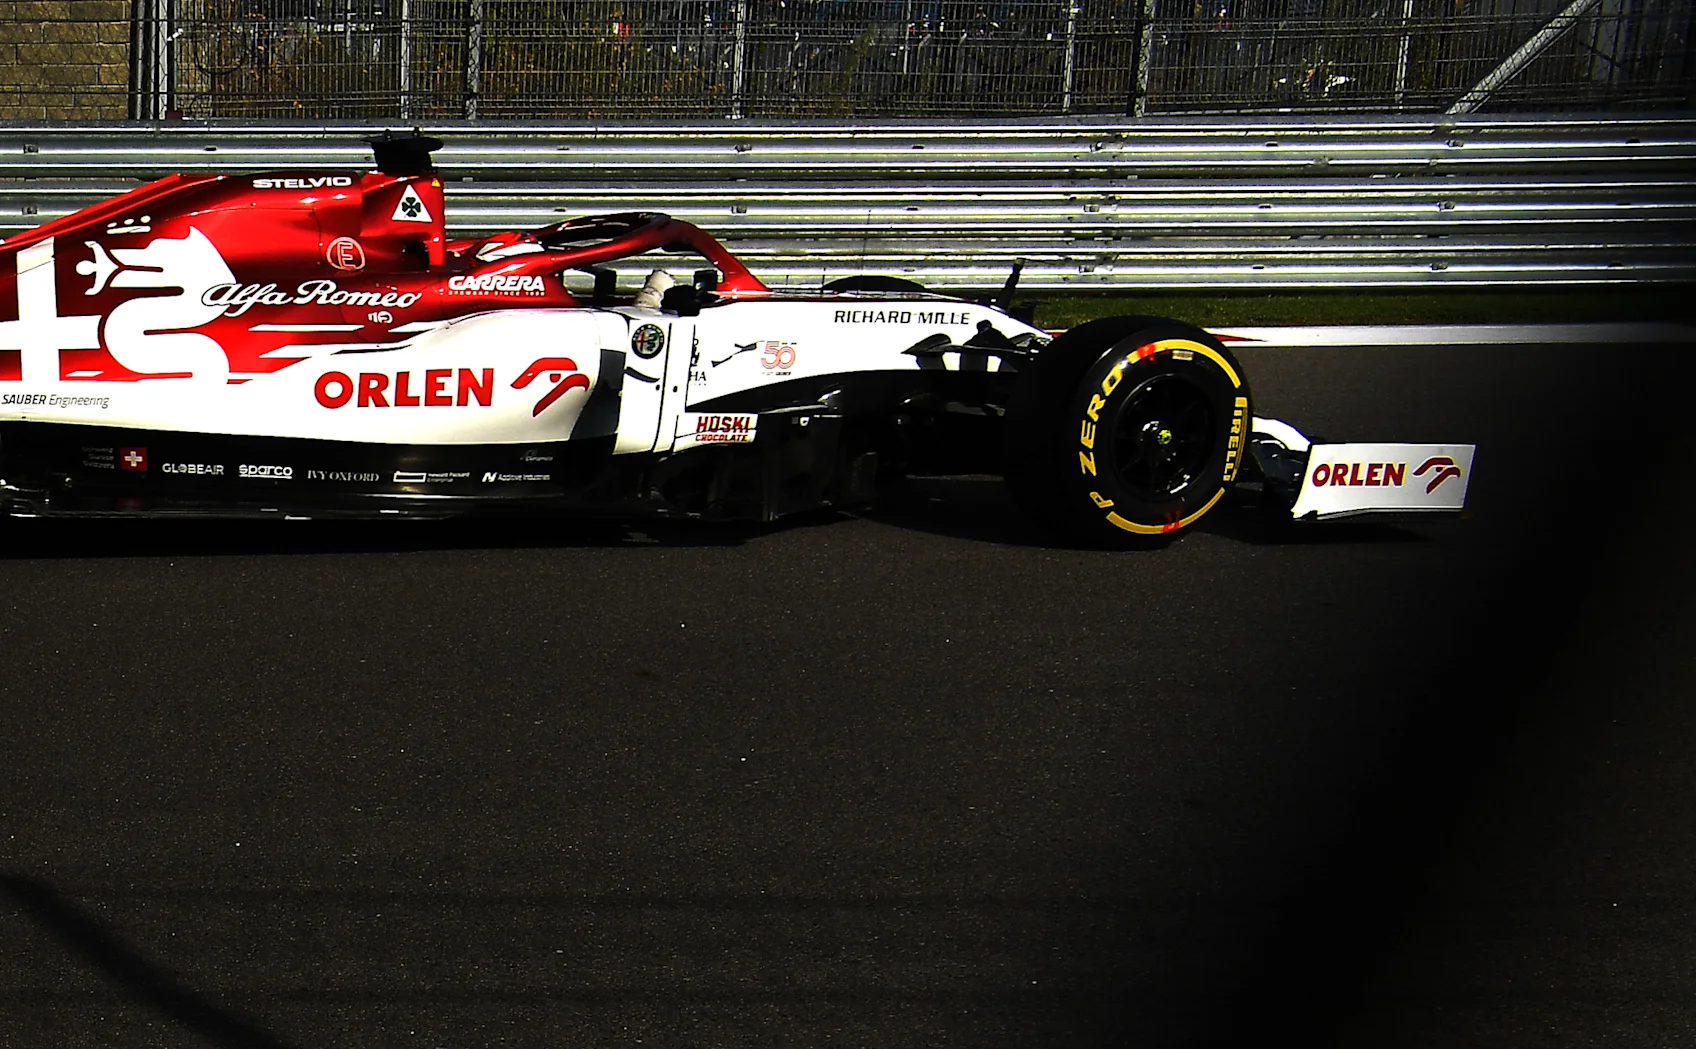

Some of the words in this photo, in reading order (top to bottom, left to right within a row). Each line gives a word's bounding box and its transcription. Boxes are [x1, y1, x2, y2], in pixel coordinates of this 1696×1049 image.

[253, 176, 352, 189] STELVIO
[448, 275, 545, 291] CARRERA
[202, 283, 294, 318] Alfa
[293, 280, 423, 308] Romeo
[834, 310, 912, 324] RICHARD
[917, 312, 971, 325] MILLE
[314, 368, 495, 410] ORLEN
[2, 394, 47, 405] SAUBER
[48, 394, 110, 409] Engineering
[1078, 363, 1124, 477] ZERO
[695, 434, 748, 442] CHOCOLATE
[1222, 396, 1249, 482] PIRELLI
[162, 463, 224, 475] GLOBEAIR
[239, 464, 293, 479] sparco
[307, 469, 328, 480] IVY
[329, 471, 380, 482] OXFORD
[1312, 463, 1406, 488] ORLEN
